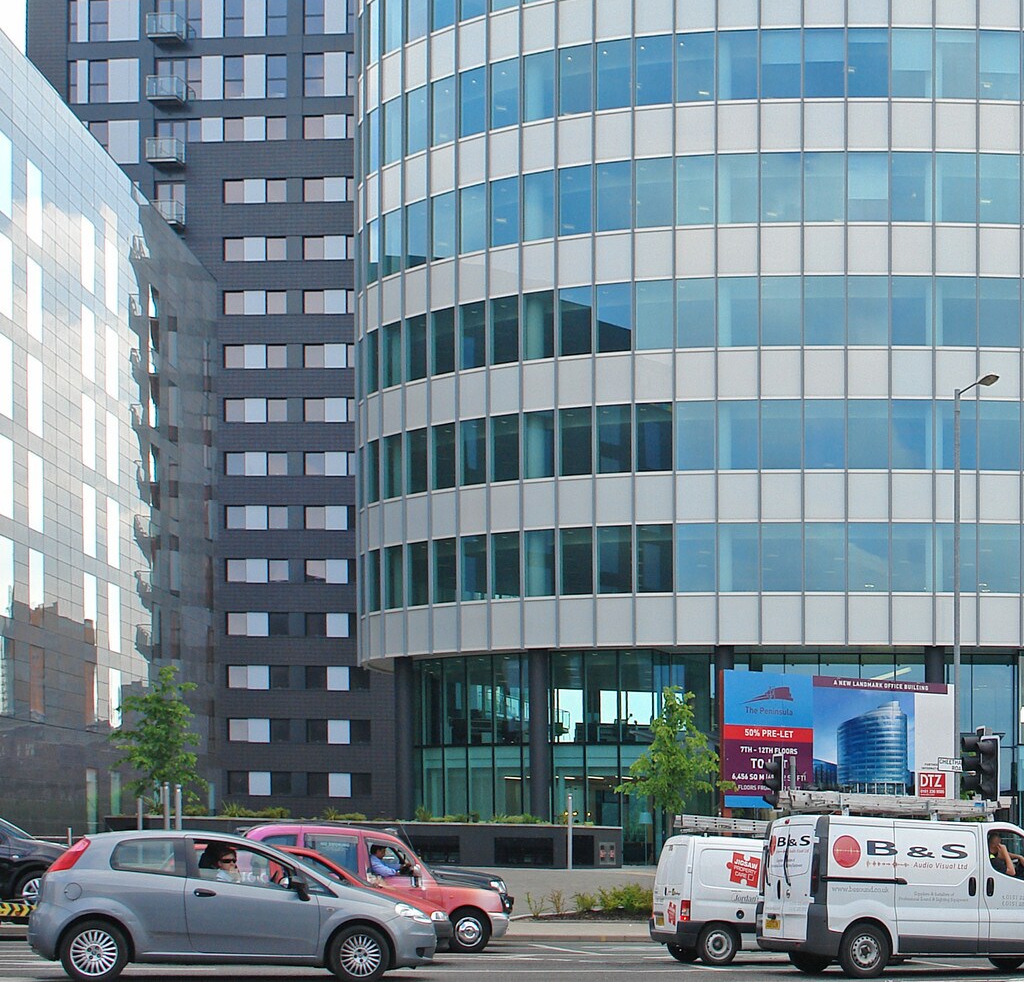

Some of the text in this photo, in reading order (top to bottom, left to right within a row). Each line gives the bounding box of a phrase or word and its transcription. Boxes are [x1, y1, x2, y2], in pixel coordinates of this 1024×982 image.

[746, 706, 793, 716] The Peninsula
[745, 728, 794, 739] 50% PRE-LET
[751, 758, 764, 769] TO
[732, 773, 748, 781] 6,456
[921, 774, 942, 788] DTZ
[778, 836, 786, 847] B
[799, 835, 810, 846] S
[866, 840, 968, 859] B & S
[734, 859, 758, 869] JIGSAW
[733, 865, 757, 875] PROPERTY
